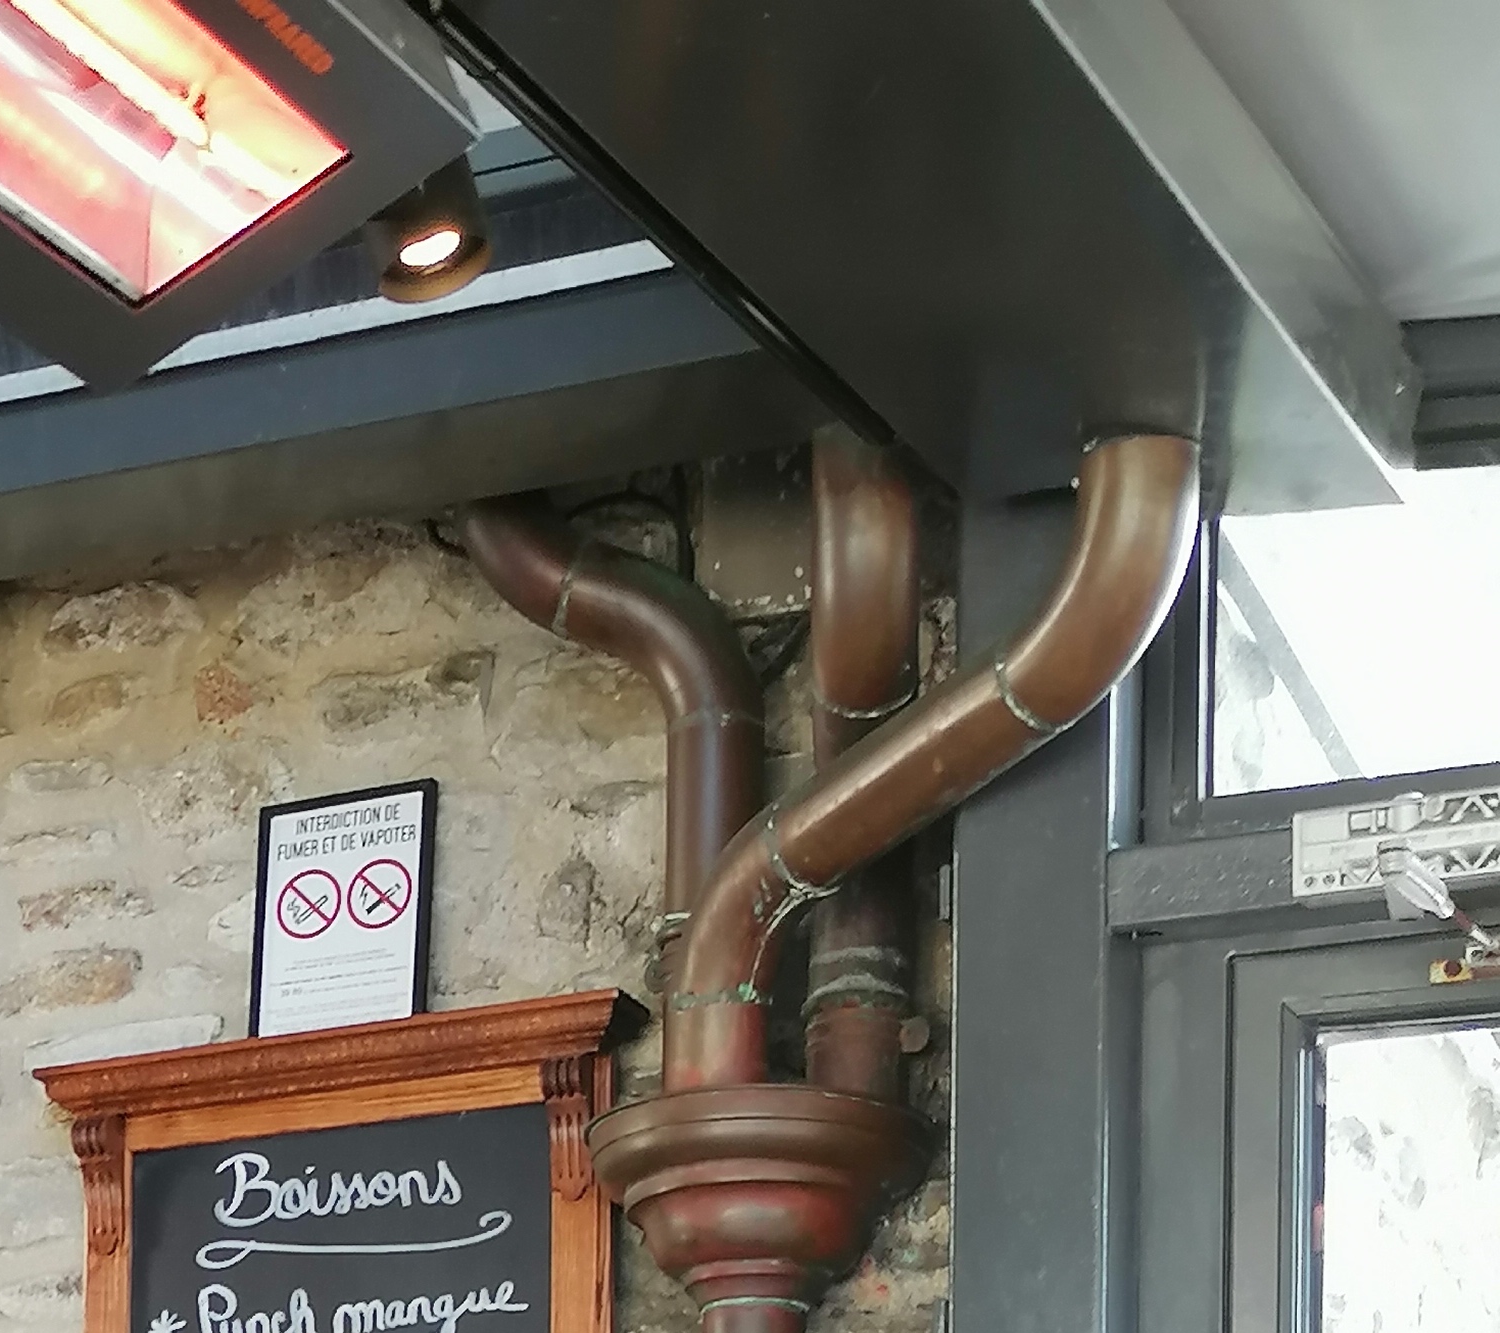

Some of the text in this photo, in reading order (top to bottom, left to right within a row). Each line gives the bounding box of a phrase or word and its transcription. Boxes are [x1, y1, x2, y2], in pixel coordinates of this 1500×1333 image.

[296, 802, 401, 835] INTERDICTION DE
[277, 824, 416, 861] FUMER ET DE VAPOTER
[213, 1152, 463, 1227] Boissons
